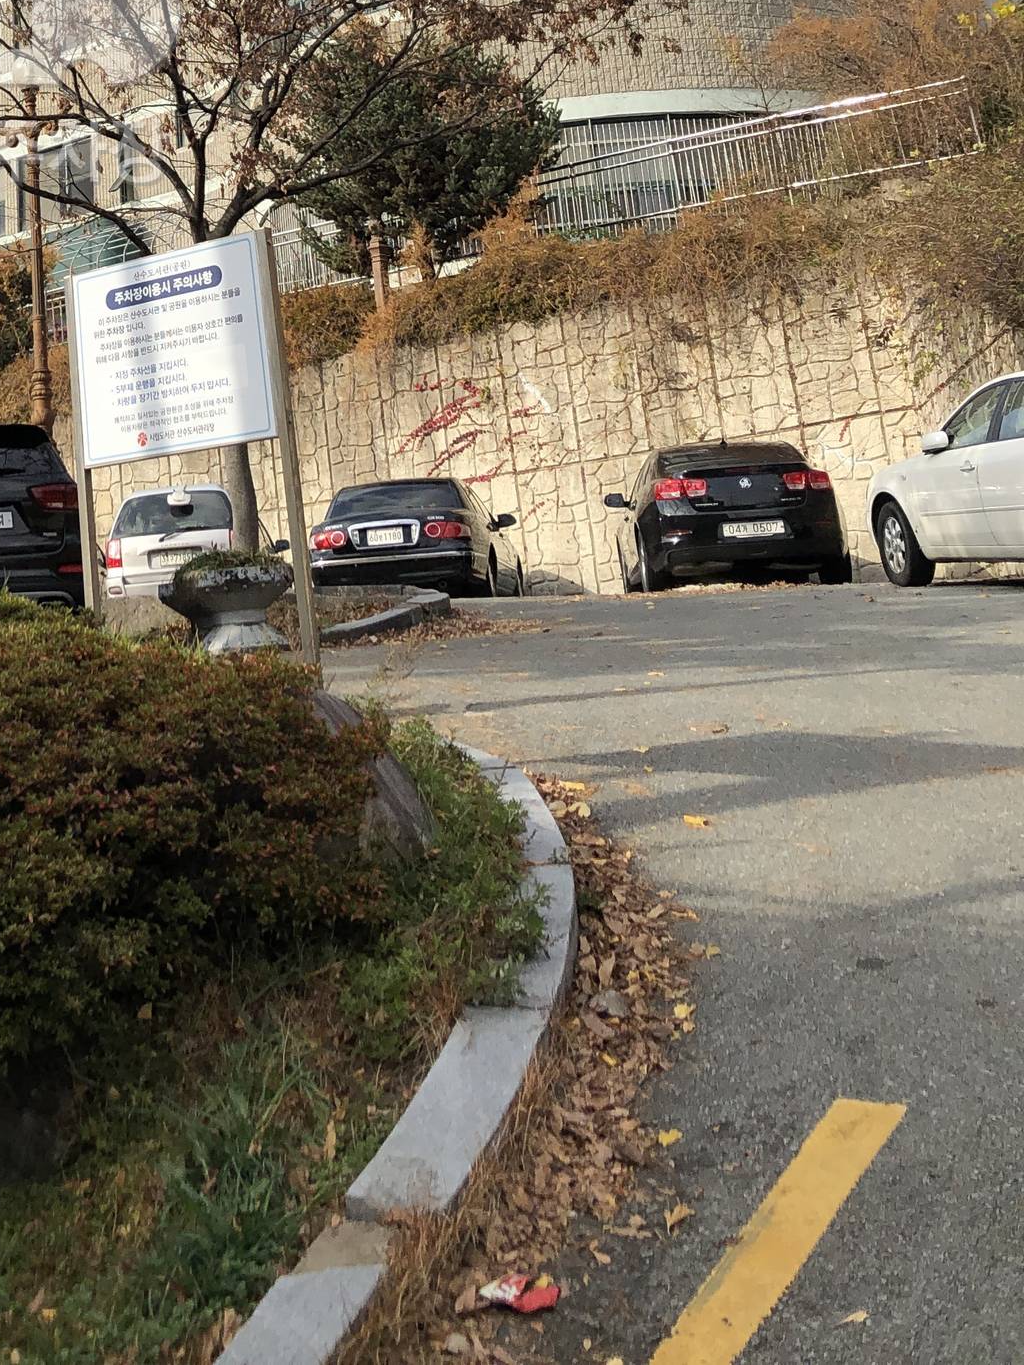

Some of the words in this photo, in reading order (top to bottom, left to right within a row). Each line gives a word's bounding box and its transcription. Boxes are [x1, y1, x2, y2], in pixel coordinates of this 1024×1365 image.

[114, 280, 170, 305] 주차장이용시
[172, 270, 213, 292] 주의사항
[98, 319, 104, 327] 이
[130, 306, 159, 319] 산수도서관
[188, 292, 219, 306] 이용하시는
[106, 326, 124, 337] 주차장
[126, 321, 145, 332] 입니다.
[140, 344, 158, 356] 반드시
[115, 370, 128, 380] 지정
[130, 364, 156, 377] 주차선을
[138, 390, 159, 404] 장기간
[752, 522, 779, 533] 0507
